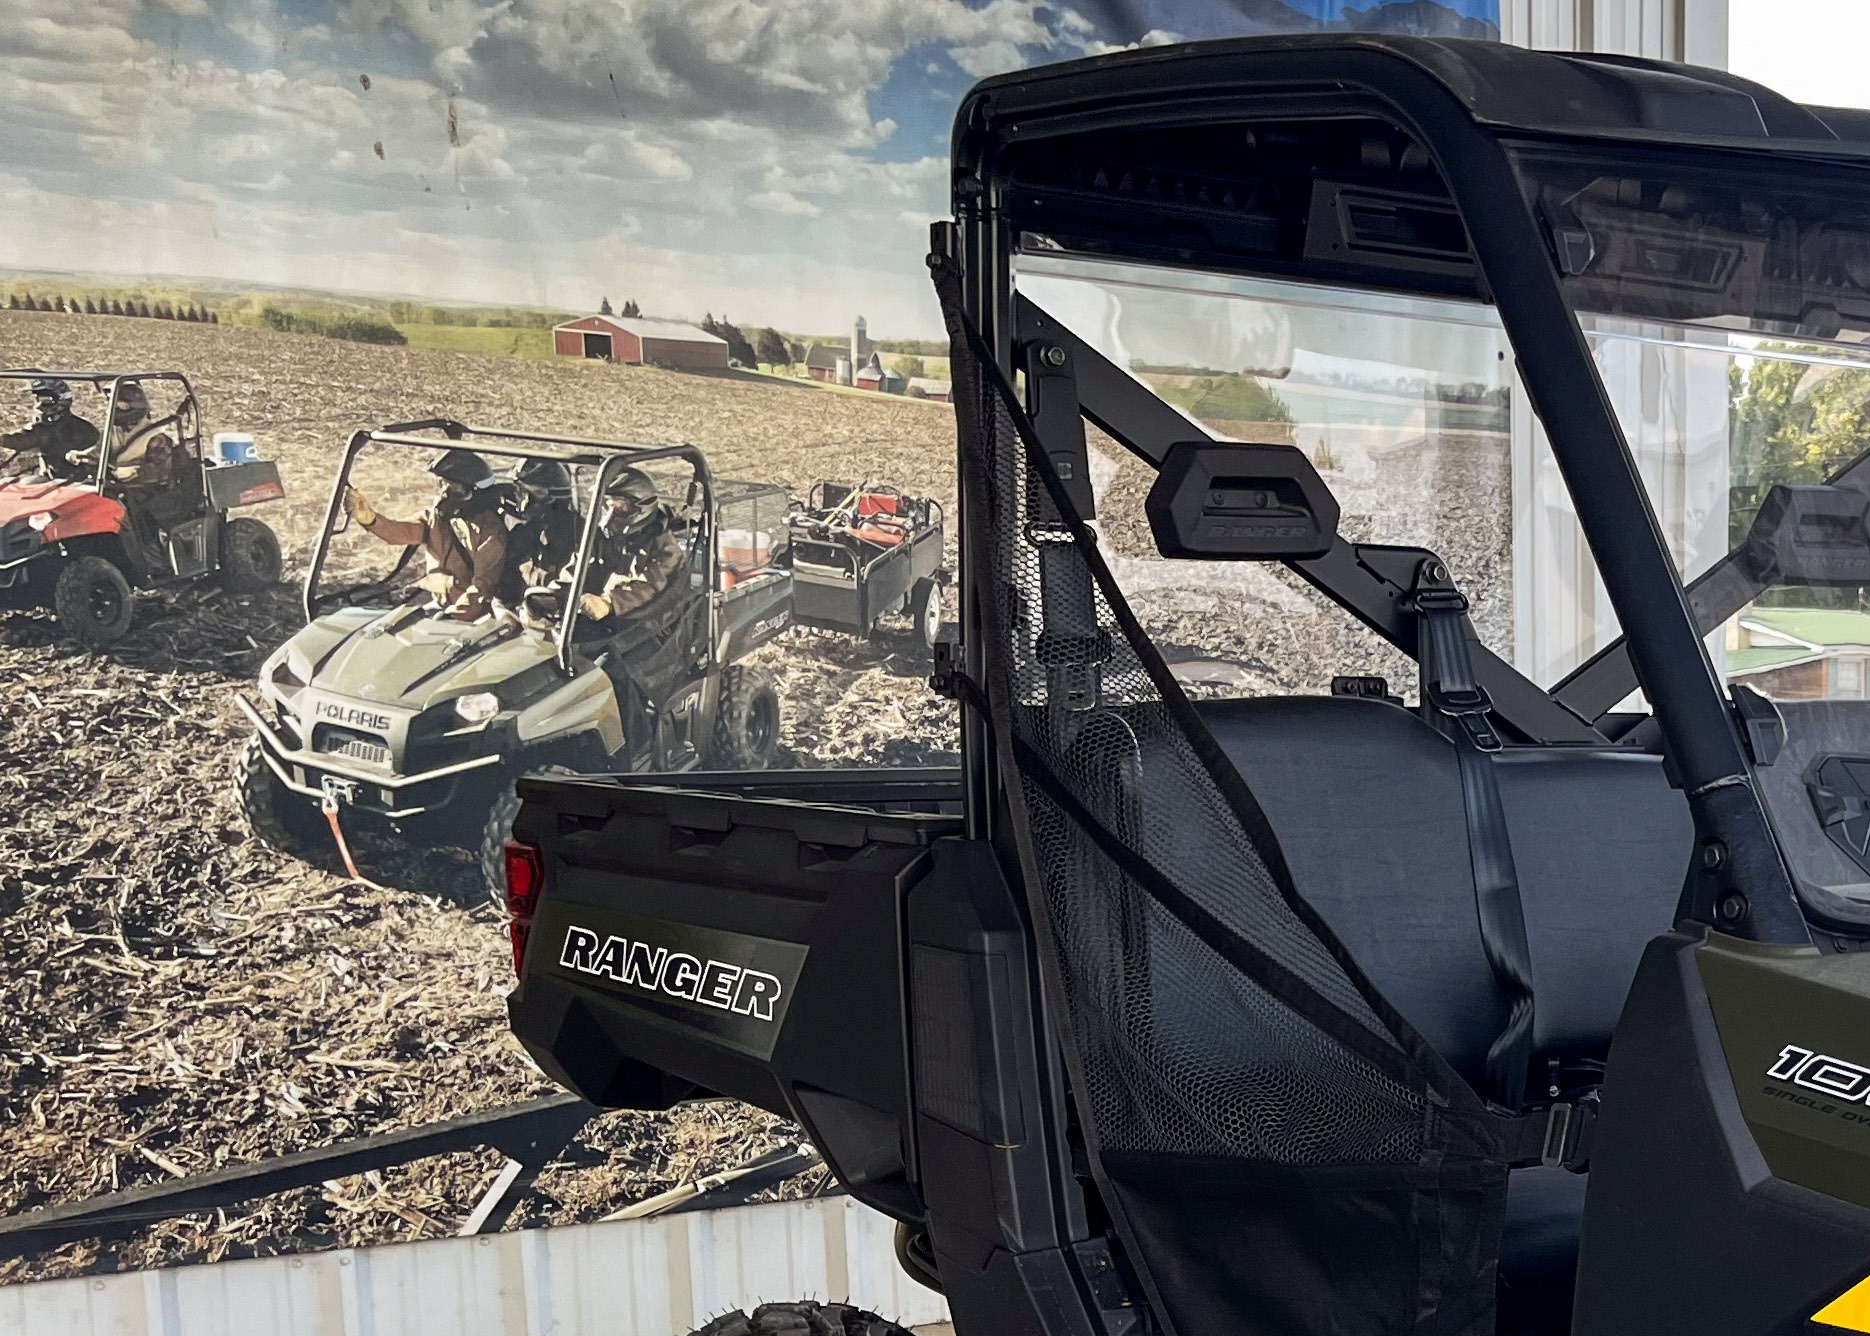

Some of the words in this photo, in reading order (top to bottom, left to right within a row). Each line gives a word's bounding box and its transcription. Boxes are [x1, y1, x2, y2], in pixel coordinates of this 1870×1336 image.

[315, 701, 391, 730] POLARIS
[560, 925, 782, 1021] RANGER
[1762, 1086, 1838, 1115] SINGLE
